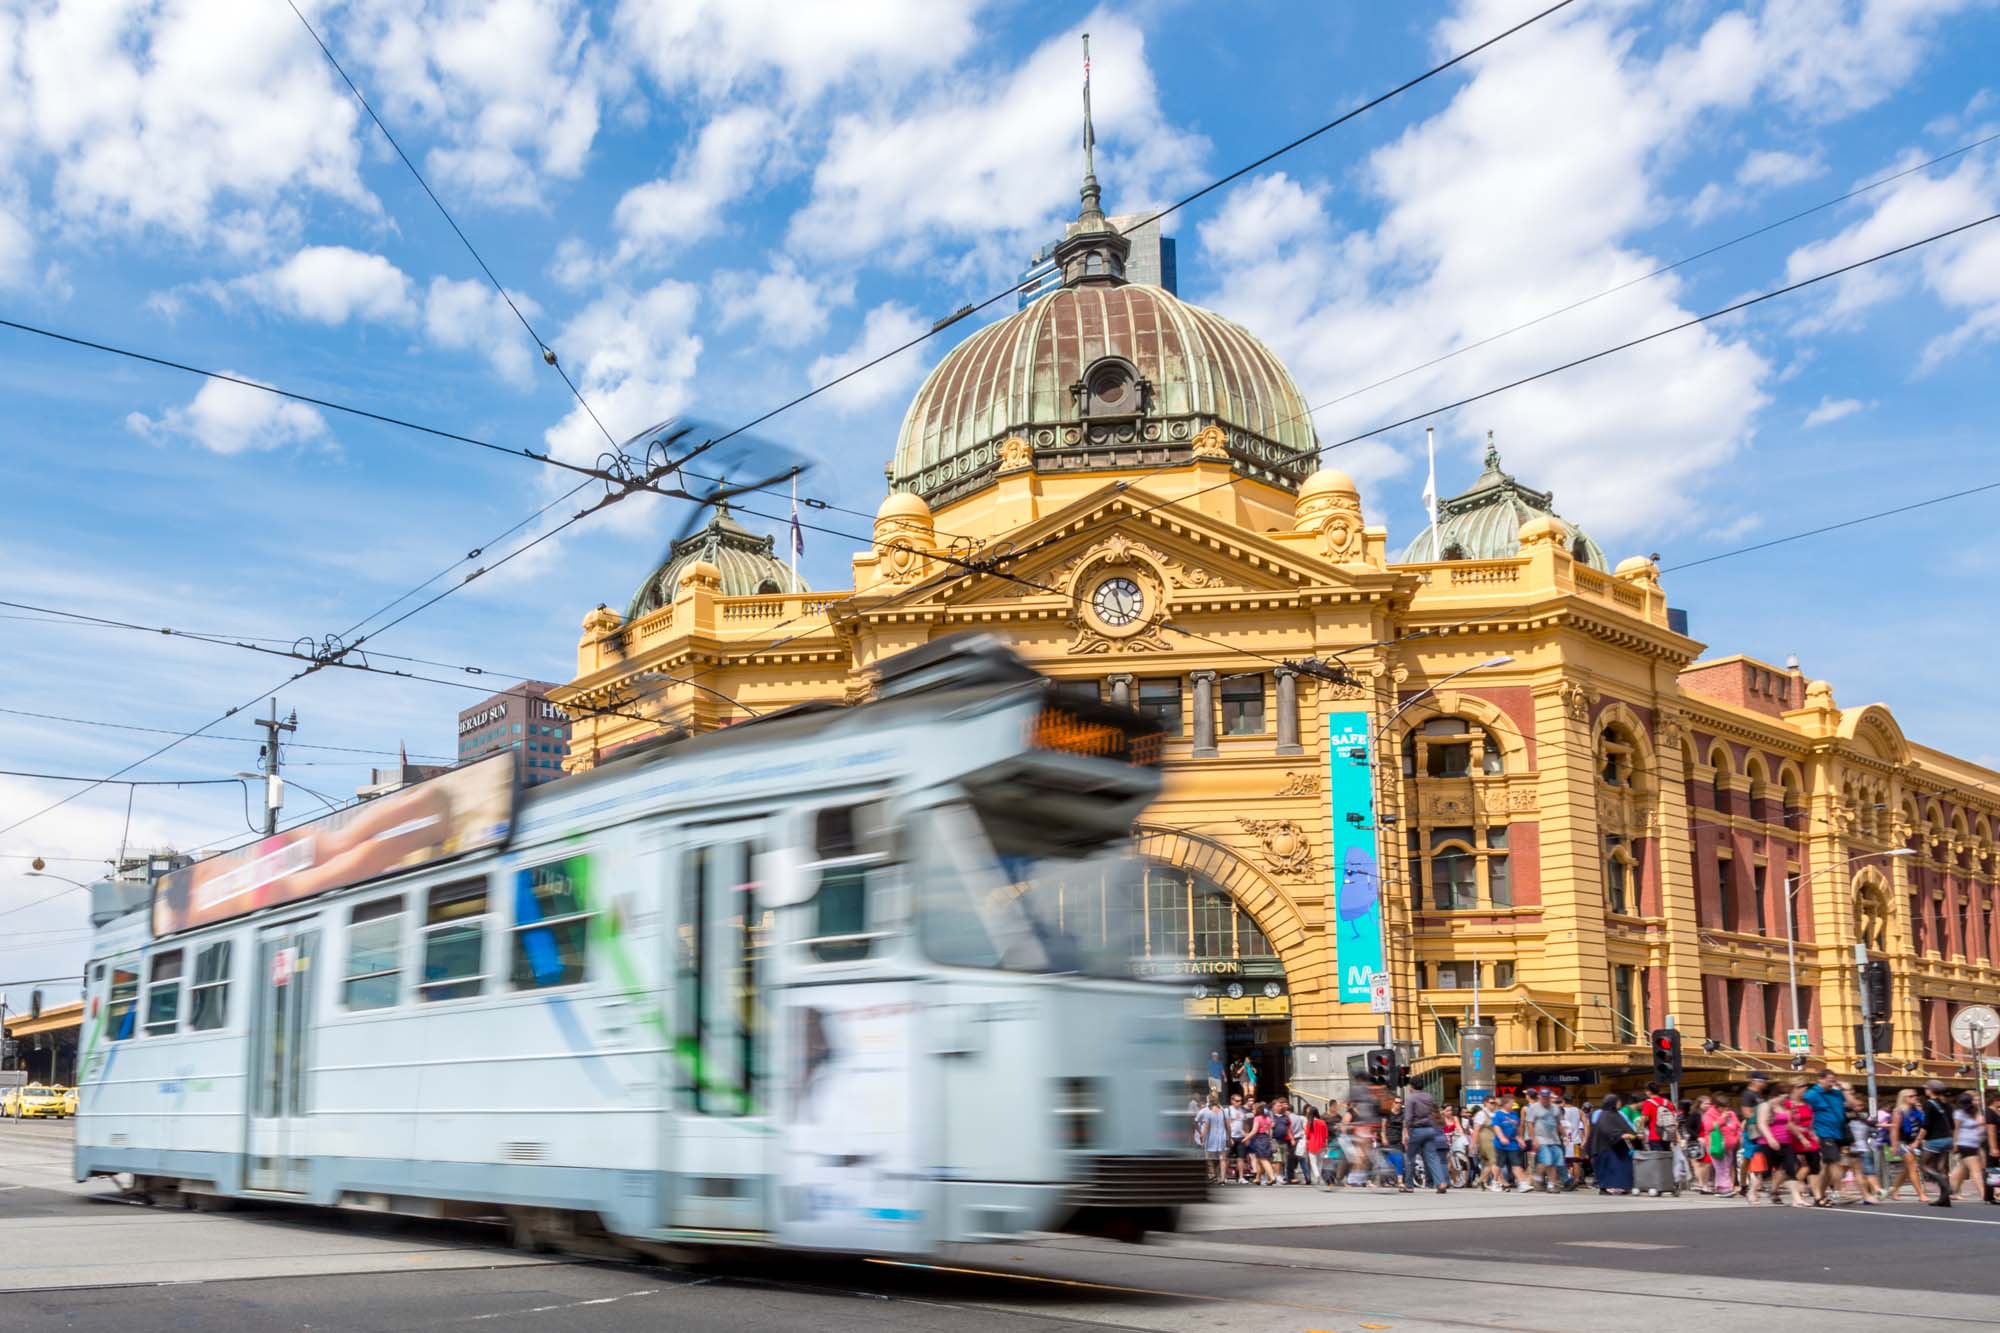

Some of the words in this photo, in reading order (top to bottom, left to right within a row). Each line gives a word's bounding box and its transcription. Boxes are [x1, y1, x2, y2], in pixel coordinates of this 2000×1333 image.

[459, 711, 488, 733] HERALD
[489, 703, 507, 720] SUN
[541, 702, 572, 720] HW
[1331, 734, 1367, 746] SAFE
[1174, 962, 1238, 975] STATION
